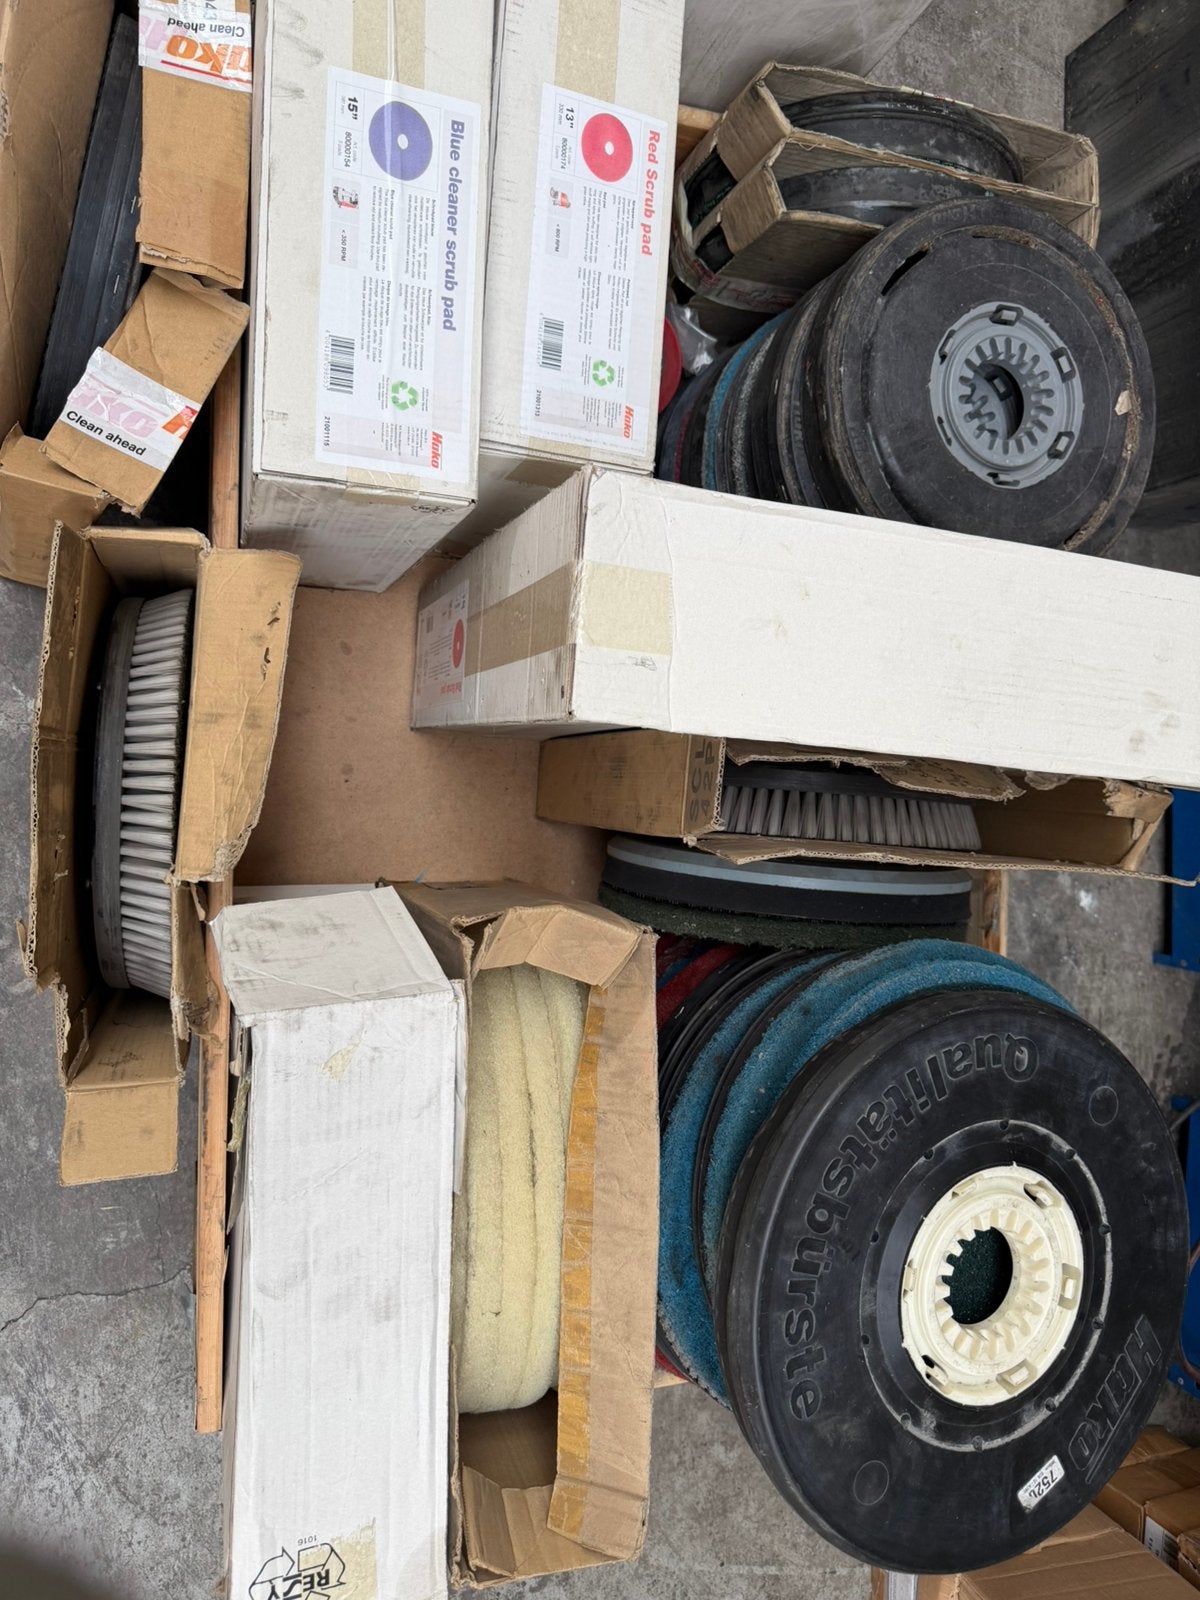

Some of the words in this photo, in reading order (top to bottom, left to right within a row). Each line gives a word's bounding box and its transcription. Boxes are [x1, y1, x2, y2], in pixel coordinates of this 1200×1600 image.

[166, 17, 206, 34] ahead
[209, 23, 245, 38] Clean
[450, 120, 465, 161] Blue
[648, 130, 661, 164] Red
[446, 167, 462, 236] cleaner
[644, 169, 657, 219] Scrub
[640, 222, 653, 256] pad
[443, 240, 457, 292] scrub
[441, 297, 456, 332] pad
[66, 410, 104, 436] Clean
[105, 433, 147, 456] ahead
[622, 405, 634, 440] Hako
[431, 431, 443, 470] Hako
[784, 1032, 1040, 1421] Qualitätsbürste
[1067, 1314, 1164, 1473] Hako
[297, 1535, 317, 1546] 1016
